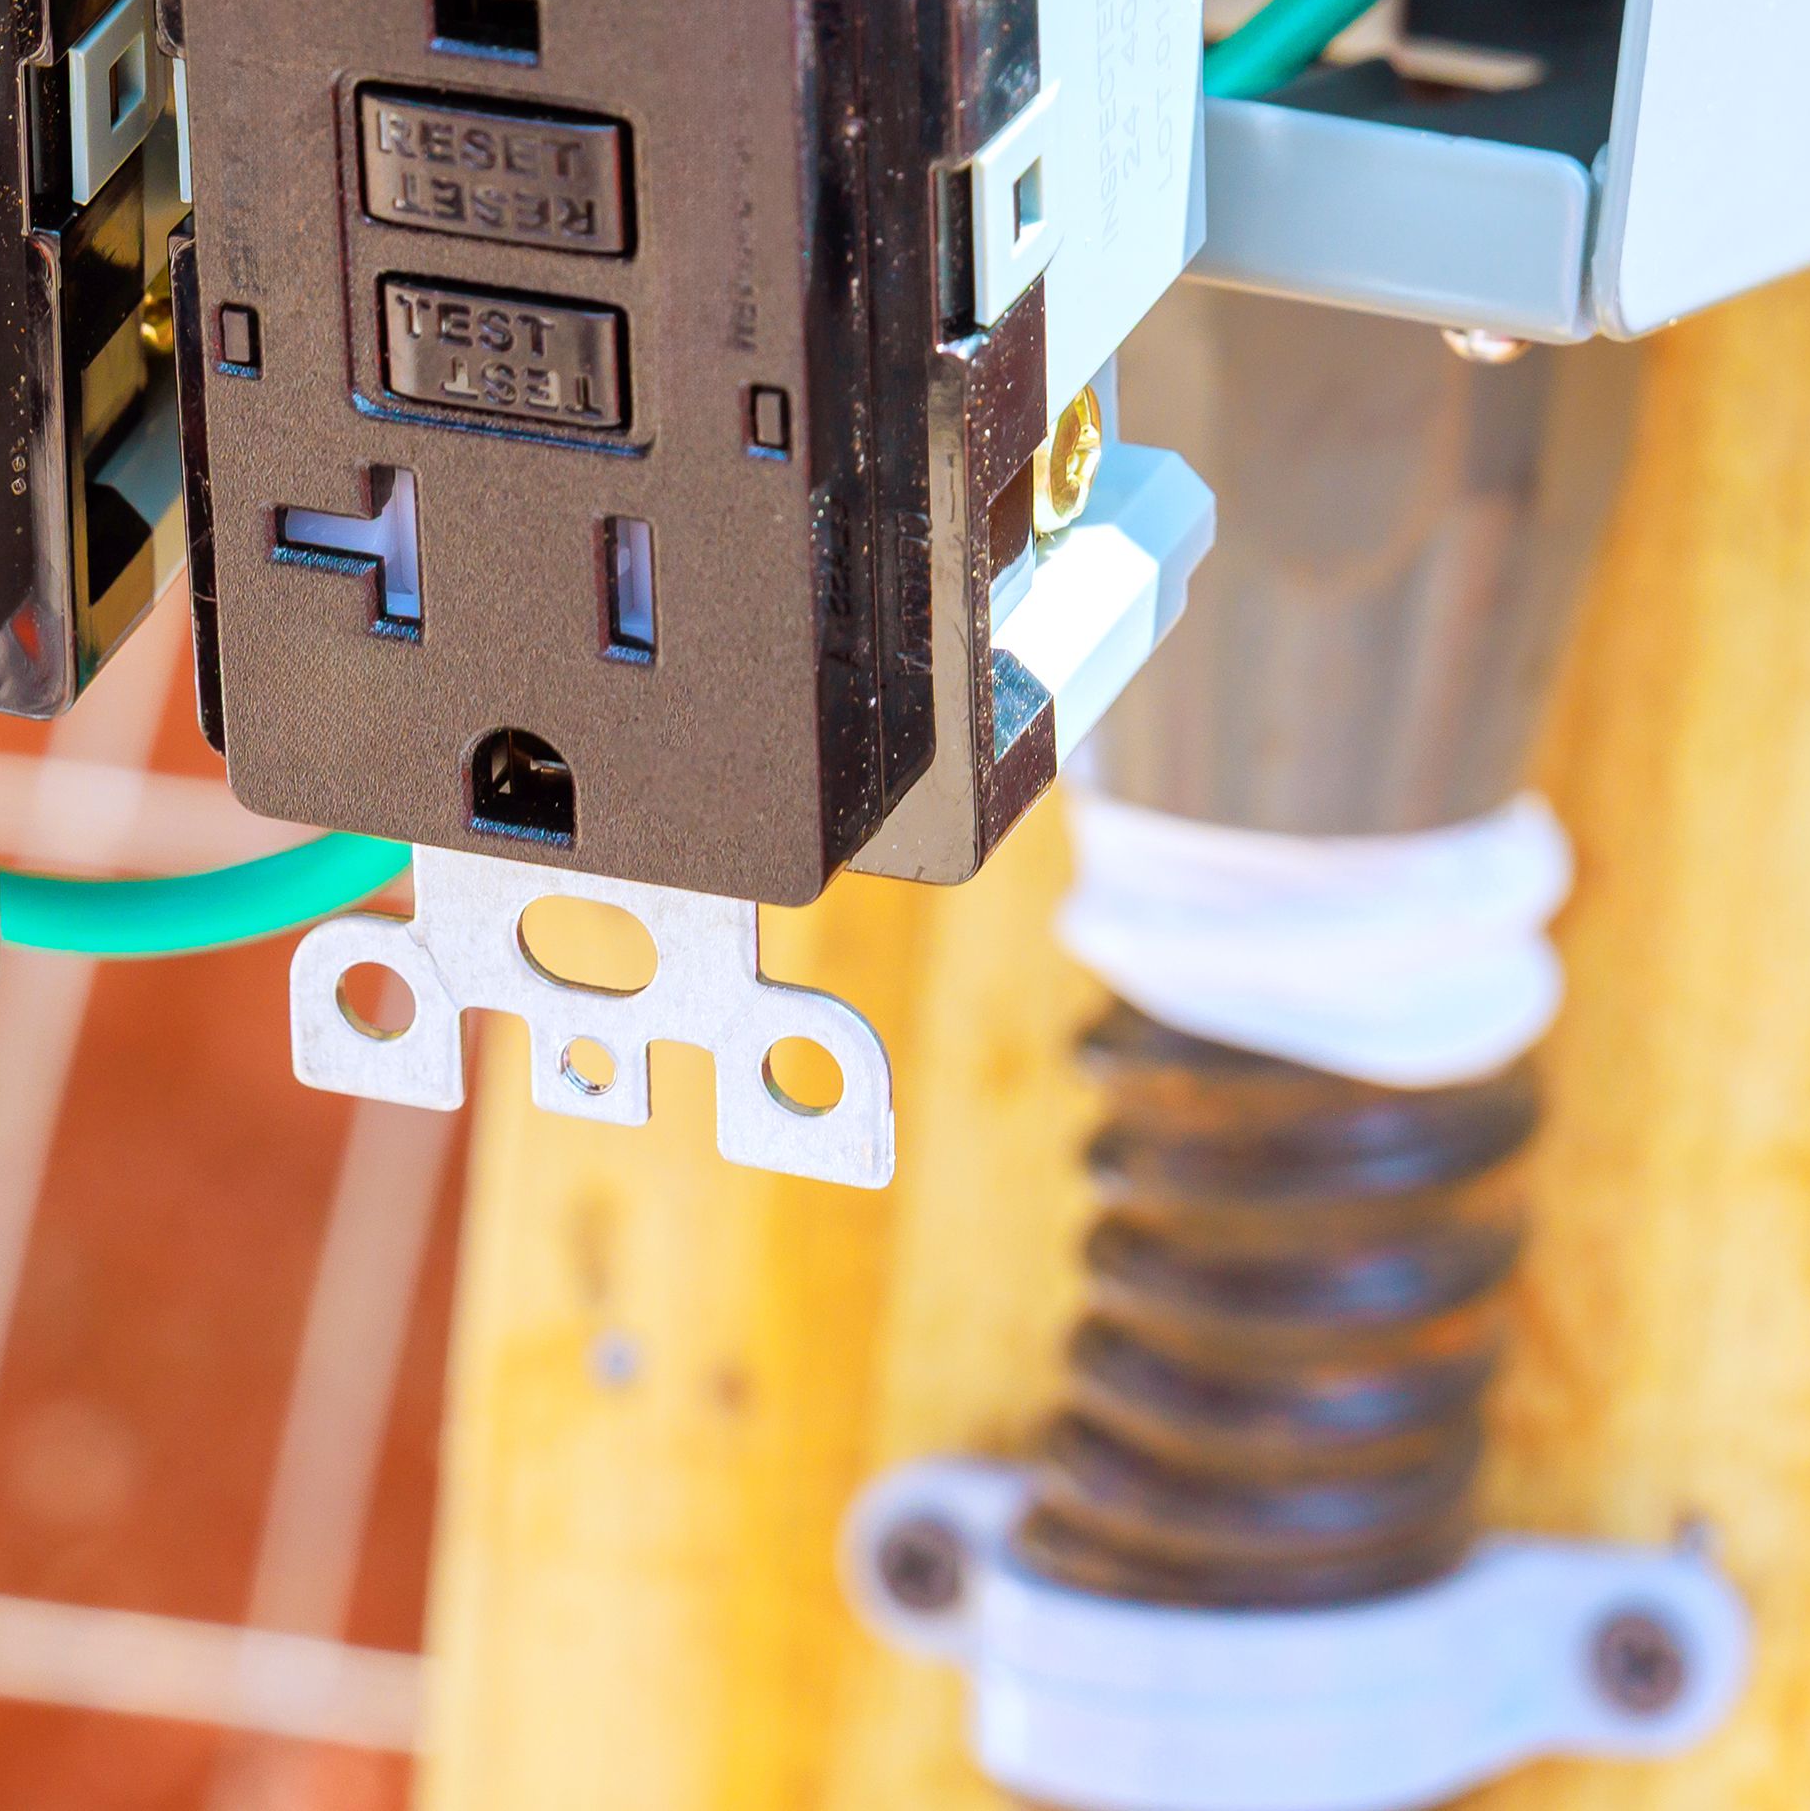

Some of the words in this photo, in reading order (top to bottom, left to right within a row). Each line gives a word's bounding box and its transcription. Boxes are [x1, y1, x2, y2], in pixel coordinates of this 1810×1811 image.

[376, 108, 582, 178] RESET
[1122, 105, 1140, 180] 24
[392, 171, 597, 239] RESET
[395, 292, 555, 357] TEST
[441, 356, 603, 419] TEST
